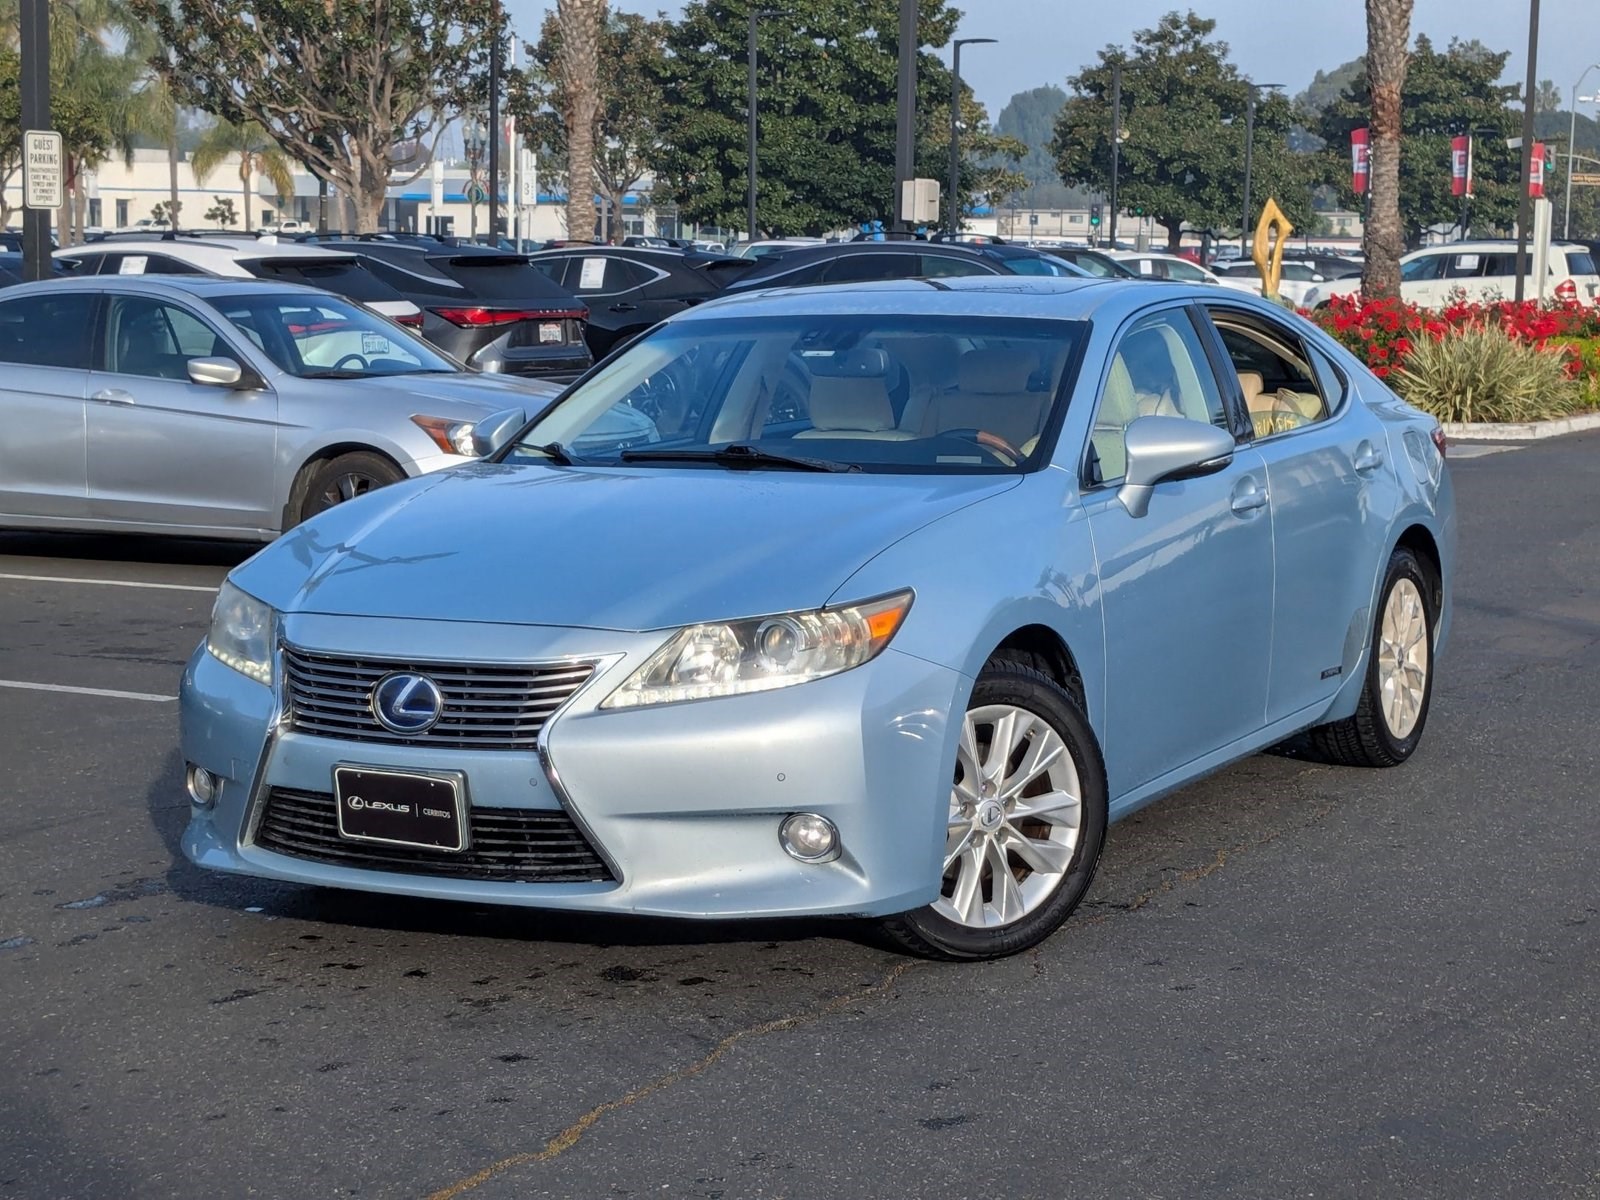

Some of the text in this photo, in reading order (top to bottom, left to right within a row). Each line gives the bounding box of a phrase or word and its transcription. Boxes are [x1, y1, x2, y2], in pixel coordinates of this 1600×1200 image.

[33, 139, 53, 150] GUEST
[30, 153, 58, 165] PARKING
[365, 800, 410, 813] LEXUS
